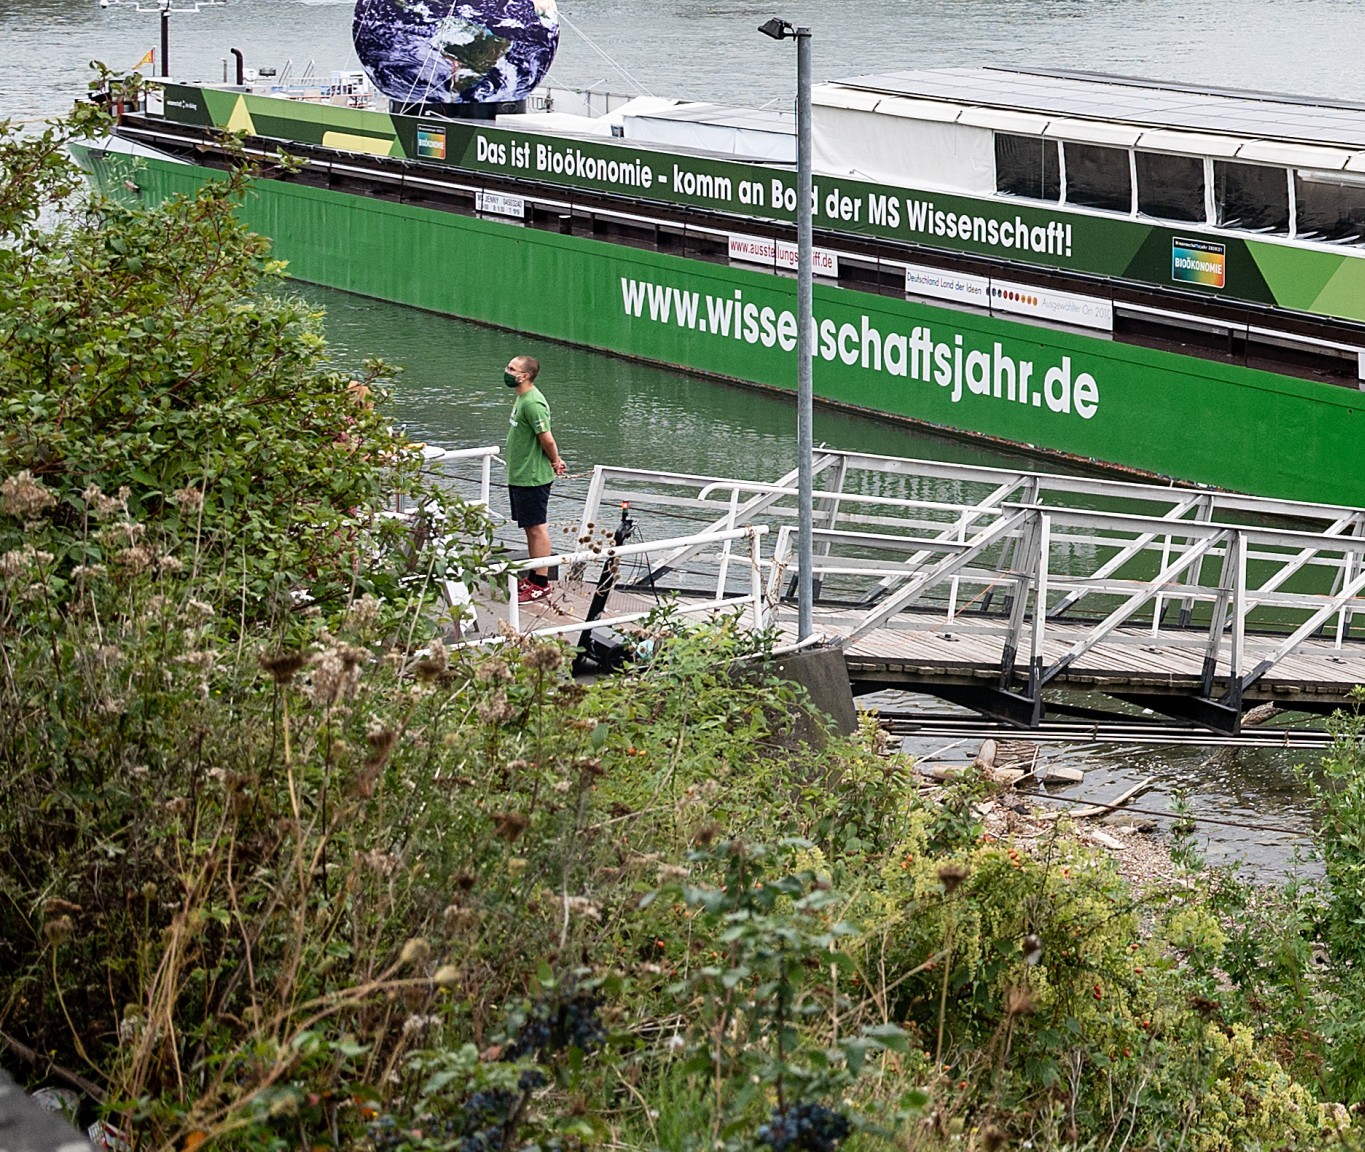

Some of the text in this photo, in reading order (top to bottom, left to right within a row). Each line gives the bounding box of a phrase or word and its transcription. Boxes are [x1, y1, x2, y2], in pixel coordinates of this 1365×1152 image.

[477, 135, 506, 165] Das
[511, 140, 531, 168] ist
[537, 143, 652, 188] Bioökonomie
[674, 164, 732, 201] komm
[739, 181, 764, 206] an
[771, 179, 818, 216] Bod
[826, 188, 862, 221] der
[868, 193, 900, 229] MS
[906, 199, 1072, 257] Wissenschaft!
[730, 239, 833, 269] www.ausstelungsiff.de
[1175, 257, 1222, 275] BIOÖKONOMIE
[907, 271, 982, 296] Deutschland Land der Ideen
[1082, 301, 1093, 315] Ort
[1095, 305, 1112, 320] 2010
